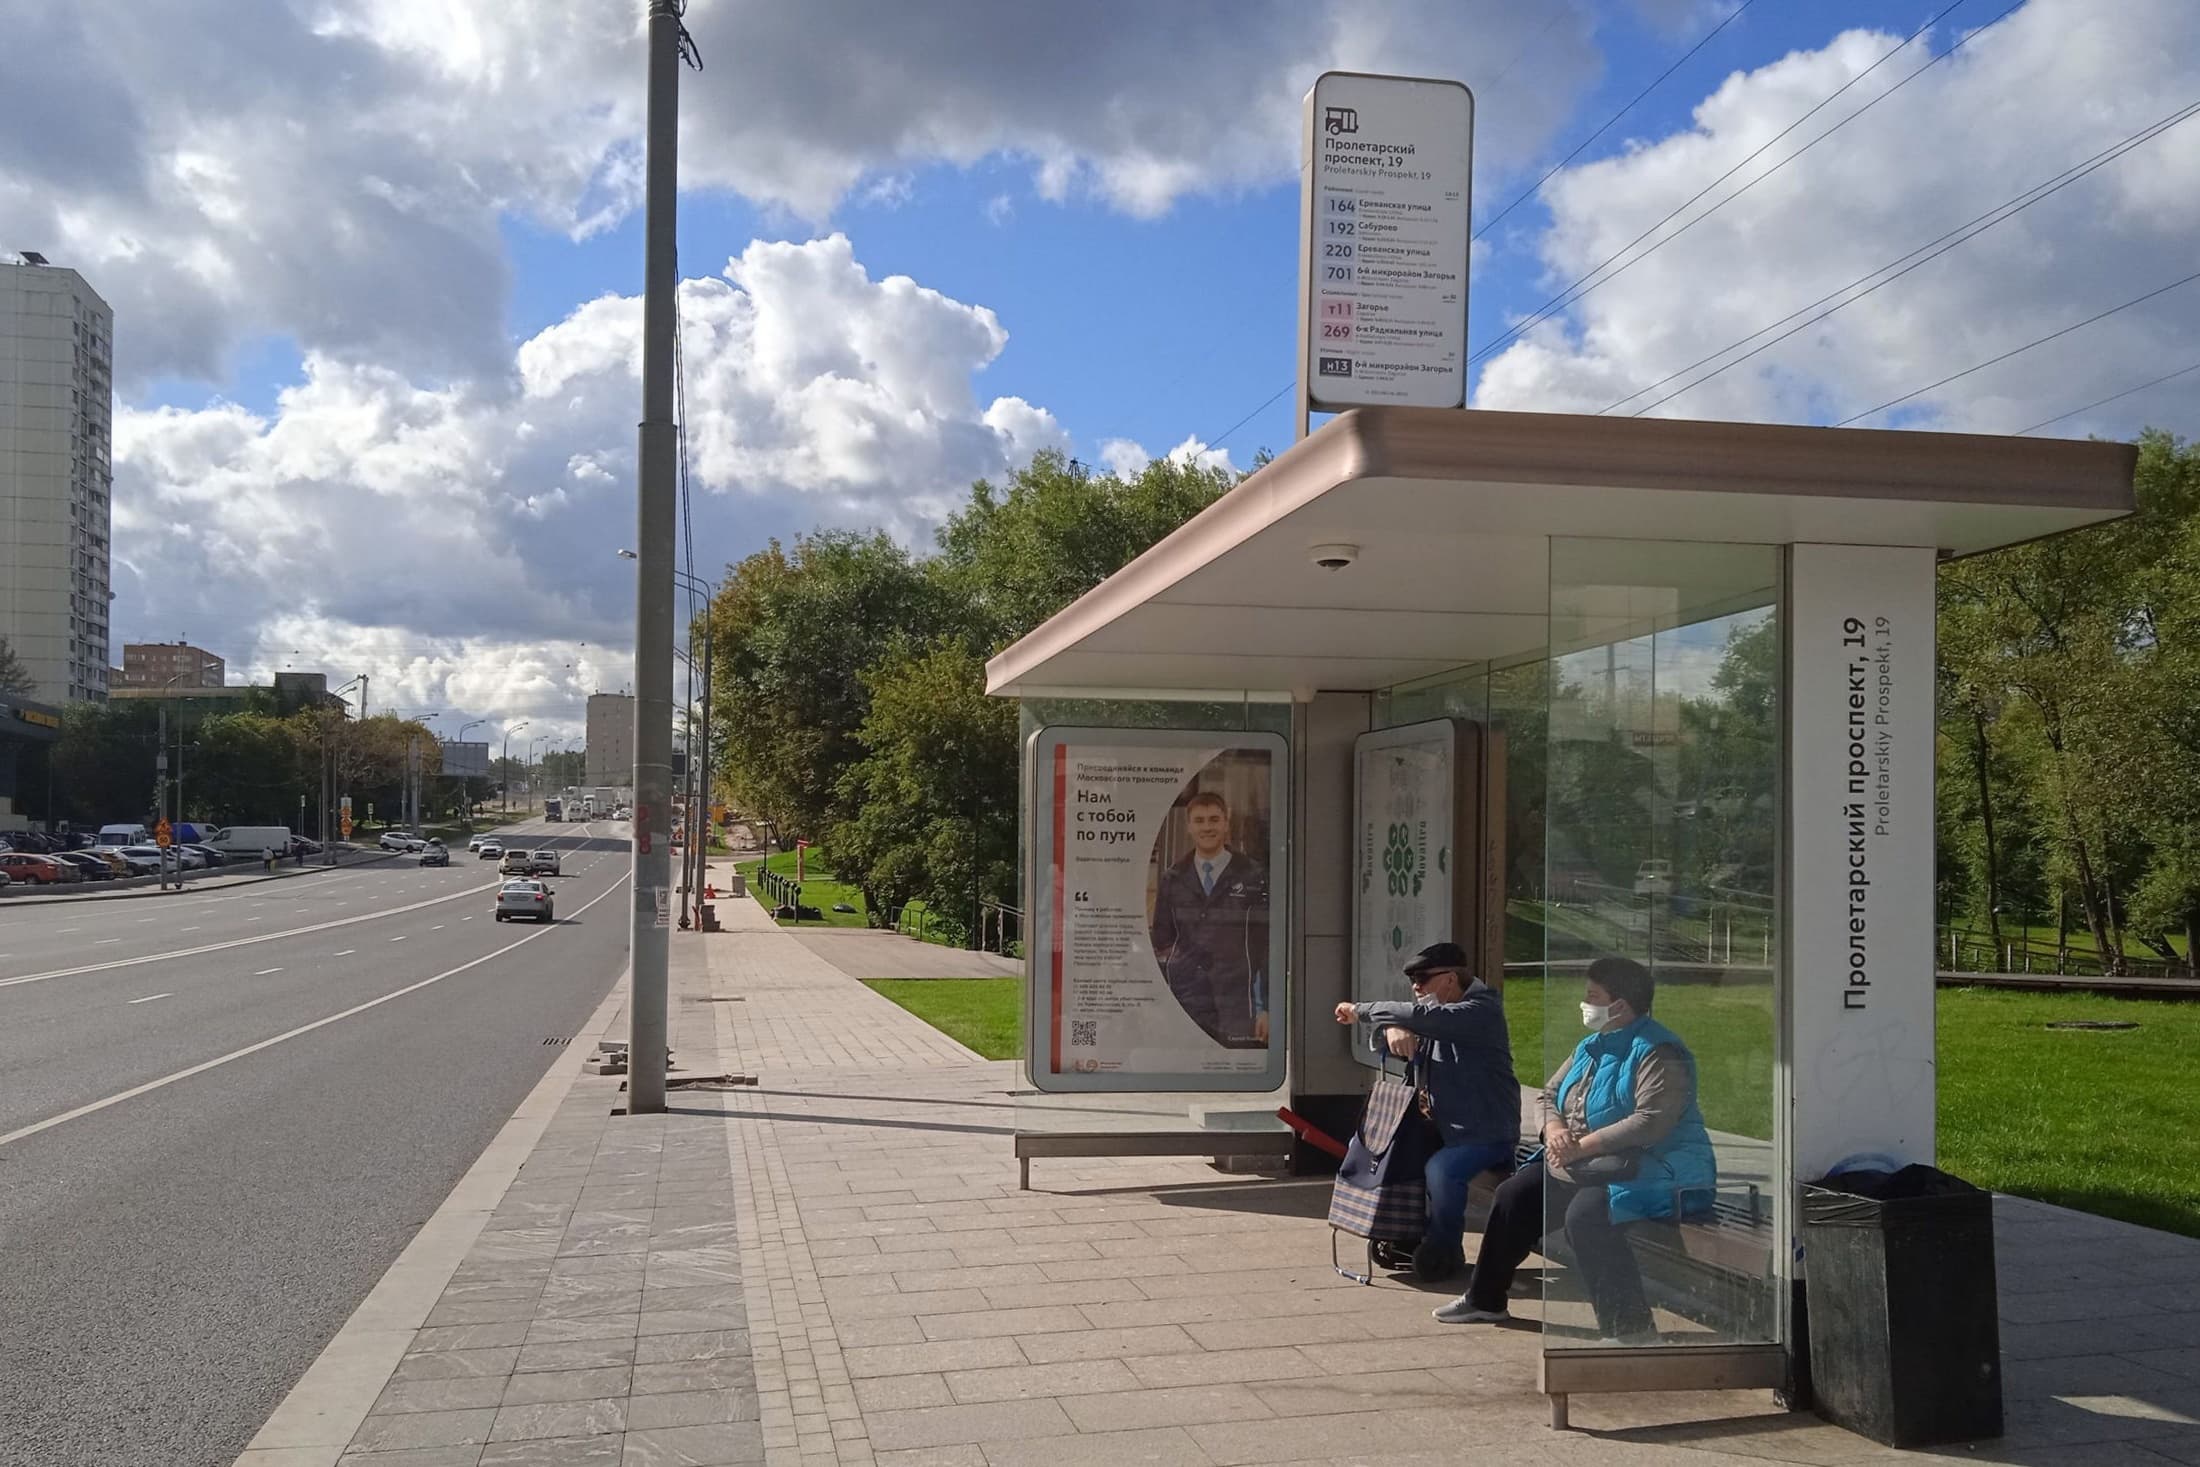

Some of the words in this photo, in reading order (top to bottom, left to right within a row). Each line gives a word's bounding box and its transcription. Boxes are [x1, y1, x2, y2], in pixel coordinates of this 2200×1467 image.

[1325, 137, 1415, 155] Пролетарский
[1325, 153, 1385, 168] проспект,
[1388, 156, 1403, 168] 19
[1324, 165, 1376, 178] Proletarskiy
[1421, 172, 1431, 180] 19
[1329, 199, 1356, 213] 164
[1359, 199, 1406, 210] Ереванская
[1407, 202, 1432, 212] улица
[1329, 221, 1355, 236] 192
[1358, 221, 1398, 232] Сабурово
[1325, 244, 1352, 258] 220
[1358, 244, 1405, 255] Ереванская
[1406, 248, 1431, 257] улица
[1327, 266, 1352, 281] 701
[1357, 267, 1370, 275] 6-й
[1371, 268, 1422, 279] микрорайон
[1423, 270, 1456, 281] Загорья
[1356, 302, 1389, 312] Загорье
[1324, 325, 1350, 338] 269
[1369, 325, 1417, 336] Радиальная
[1418, 328, 1443, 338] улица
[1368, 361, 1419, 373] микрорайон
[1843, 617, 1866, 648] 19
[1875, 616, 1890, 636] 19
[1874, 642, 1893, 726] Prospekt,
[1849, 655, 1870, 794] проспект,
[1132, 775, 1179, 785] транспорта
[1874, 731, 1893, 836] Proletarskiy
[1077, 788, 1112, 804] Нам
[1077, 811, 1084, 822] с
[1088, 808, 1136, 823] тобой
[1077, 831, 1095, 842] по
[1099, 831, 1136, 844] пути
[1843, 803, 1871, 1010] Пролетарский
